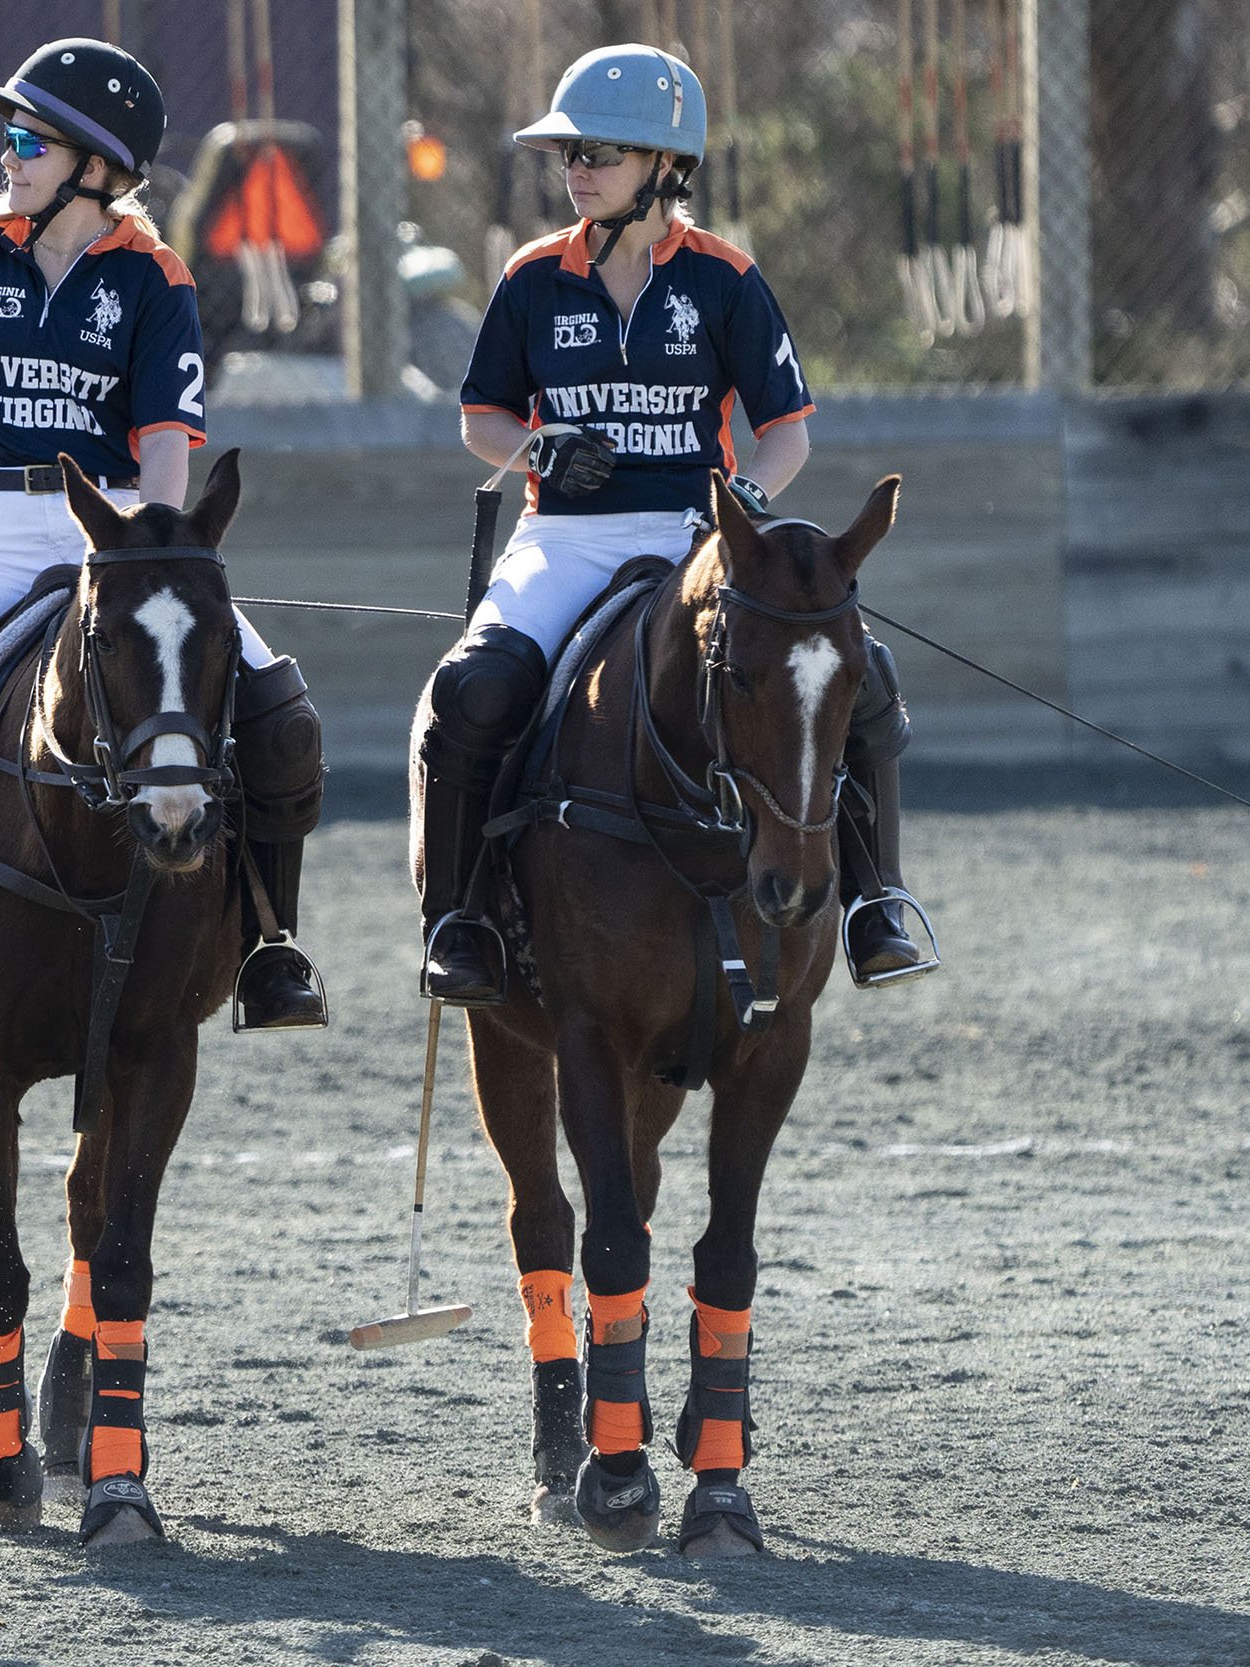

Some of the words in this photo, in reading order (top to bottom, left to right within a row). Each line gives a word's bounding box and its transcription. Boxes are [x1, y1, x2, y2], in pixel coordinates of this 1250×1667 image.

[80, 329, 112, 351] USPA
[665, 343, 698, 356] USPA
[177, 352, 206, 418] 2
